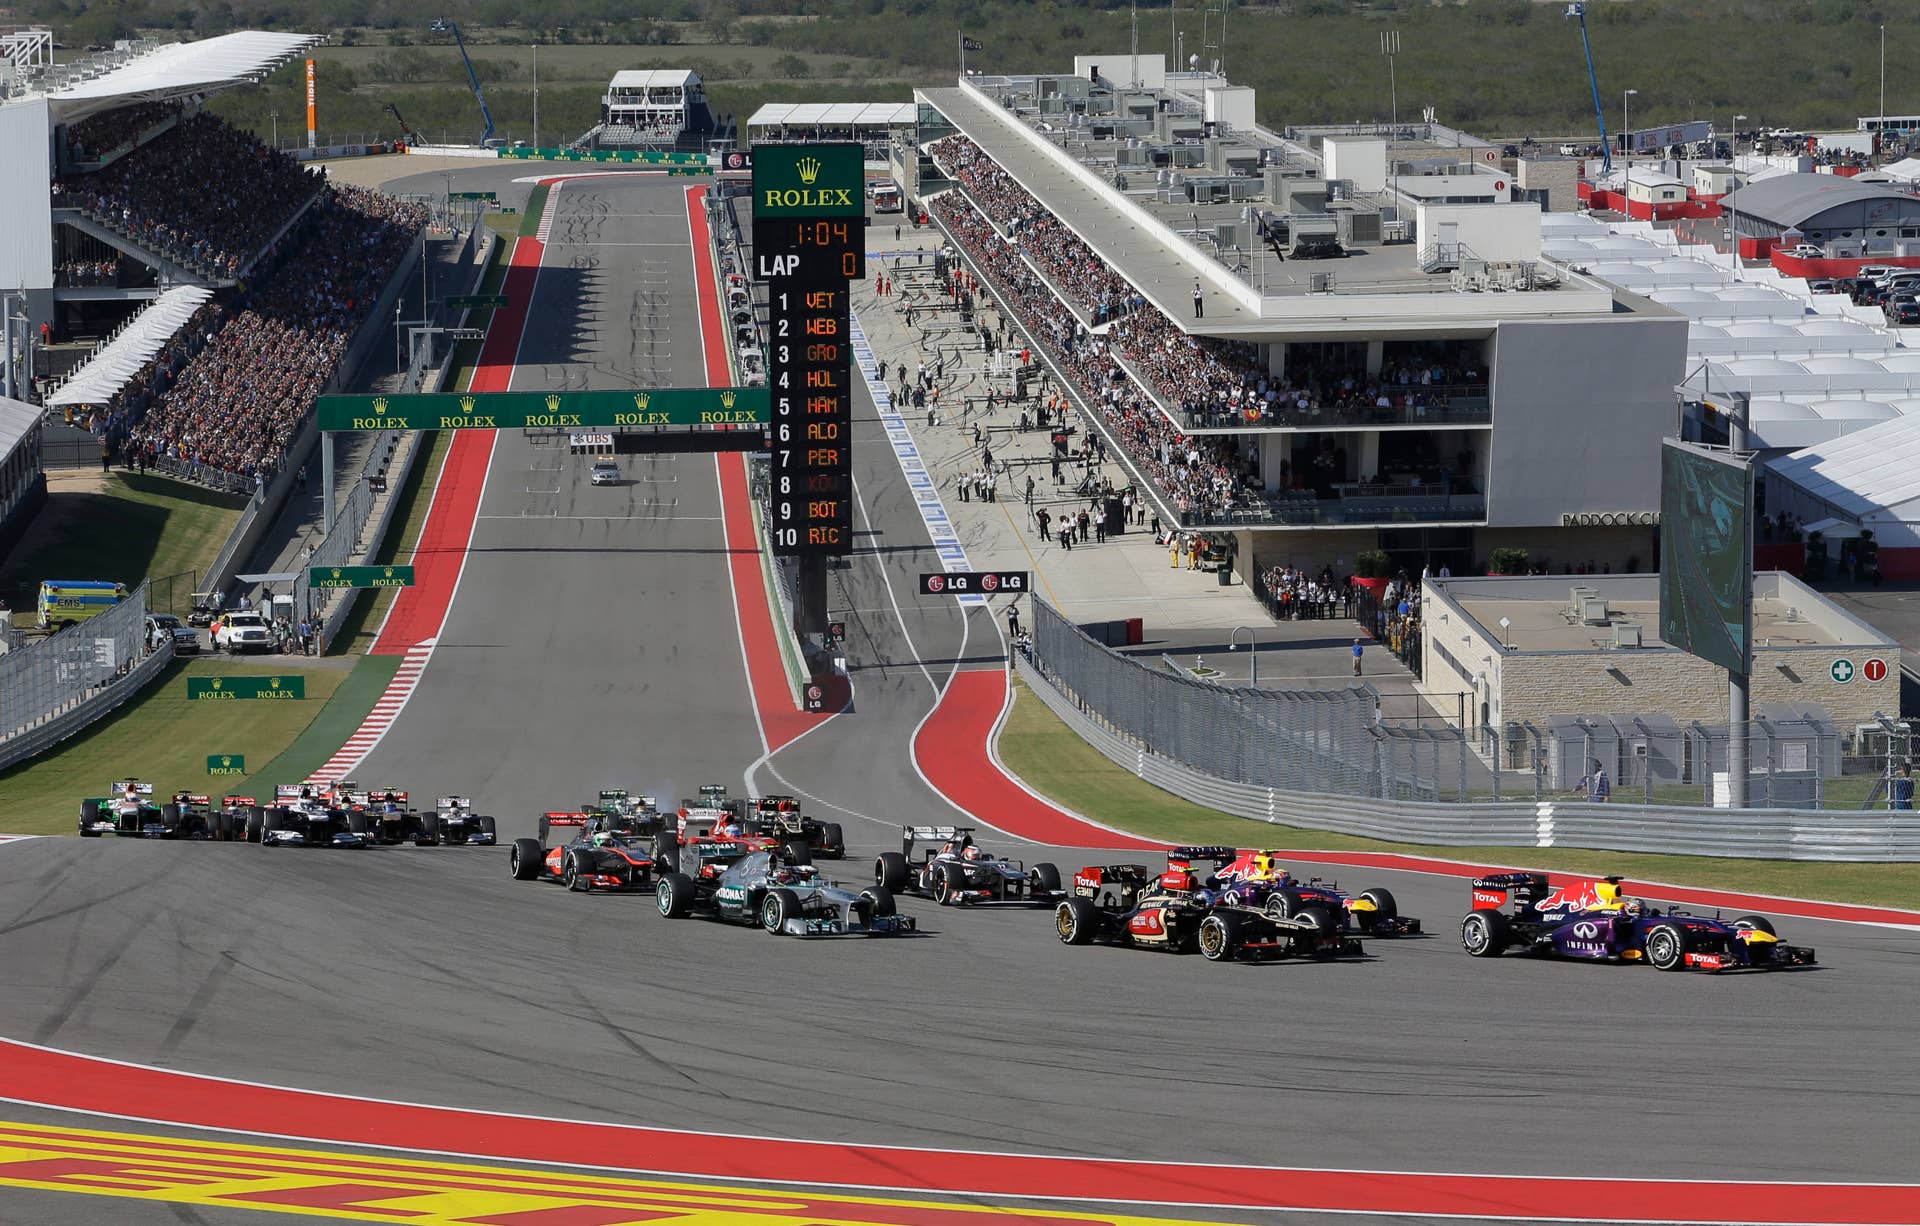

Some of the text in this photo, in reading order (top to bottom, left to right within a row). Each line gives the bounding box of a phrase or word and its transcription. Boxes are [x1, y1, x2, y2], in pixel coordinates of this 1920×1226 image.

[765, 189, 853, 206] ROLEX
[799, 222, 848, 245] 1:04
[760, 253, 856, 276] LAP 0
[779, 292, 834, 311] 1 VET
[778, 319, 837, 337] 2 WEB
[778, 345, 837, 363] 3 GRO
[778, 371, 836, 388] 4 HUL
[779, 397, 837, 415] 5 HAM
[353, 411, 757, 429] ROLEX ROLEX ROLEX ROLEX ROLEX
[586, 434, 609, 443] UBS
[779, 423, 837, 441] 6 ALO
[780, 450, 838, 467] 7 PER
[780, 476, 790, 494] 8
[781, 501, 837, 520] 9 BOT
[1561, 512, 1636, 527] PADDOCK
[776, 528, 839, 546] 10 RIC
[948, 576, 1021, 590] LG LG
[58, 599, 80, 607] EMS
[199, 690, 294, 699] ROLEX ROLEX
[210, 767, 242, 775] ROLEX
[1075, 875, 1100, 888] TOTAL
[1473, 892, 1500, 904] TOTAL
[1566, 940, 1606, 951] INFINIT
[1690, 953, 1719, 964] TOTAL
